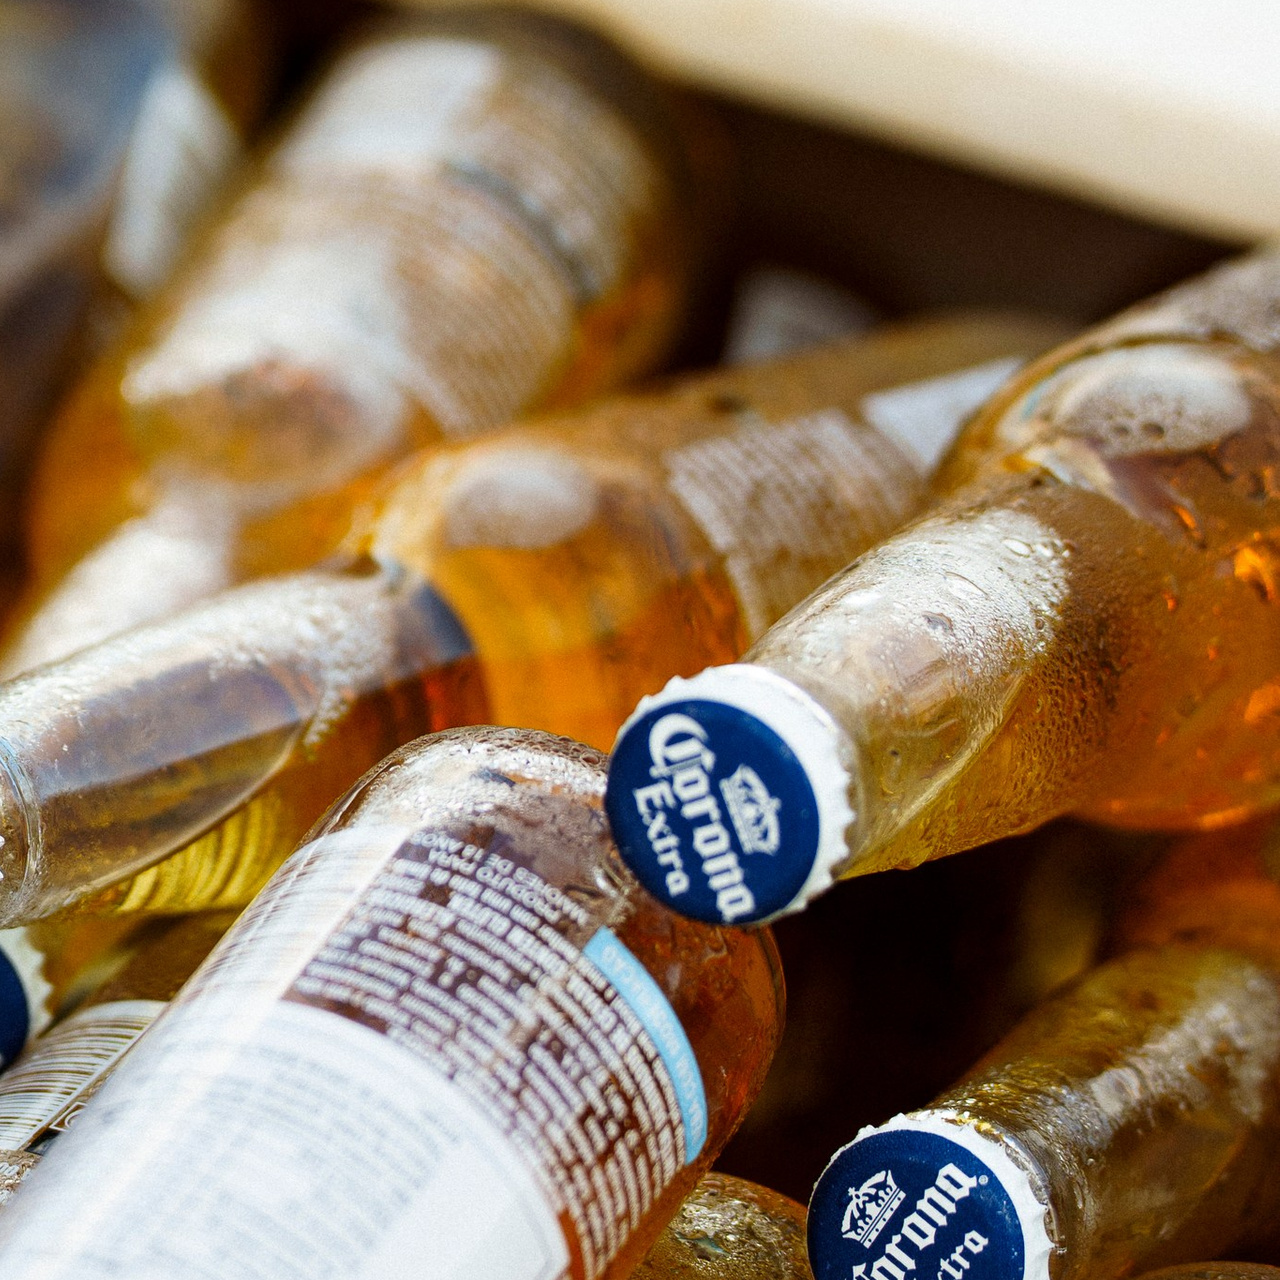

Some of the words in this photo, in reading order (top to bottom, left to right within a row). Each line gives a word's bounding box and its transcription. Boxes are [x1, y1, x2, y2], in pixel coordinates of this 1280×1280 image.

[632, 780, 691, 897] Extra
[648, 713, 756, 923] Corona
[428, 847, 477, 876] PARA
[460, 842, 483, 862] 18
[484, 850, 516, 876] DE
[474, 863, 562, 924] PRODUTO
[512, 864, 589, 925] MAIORES
